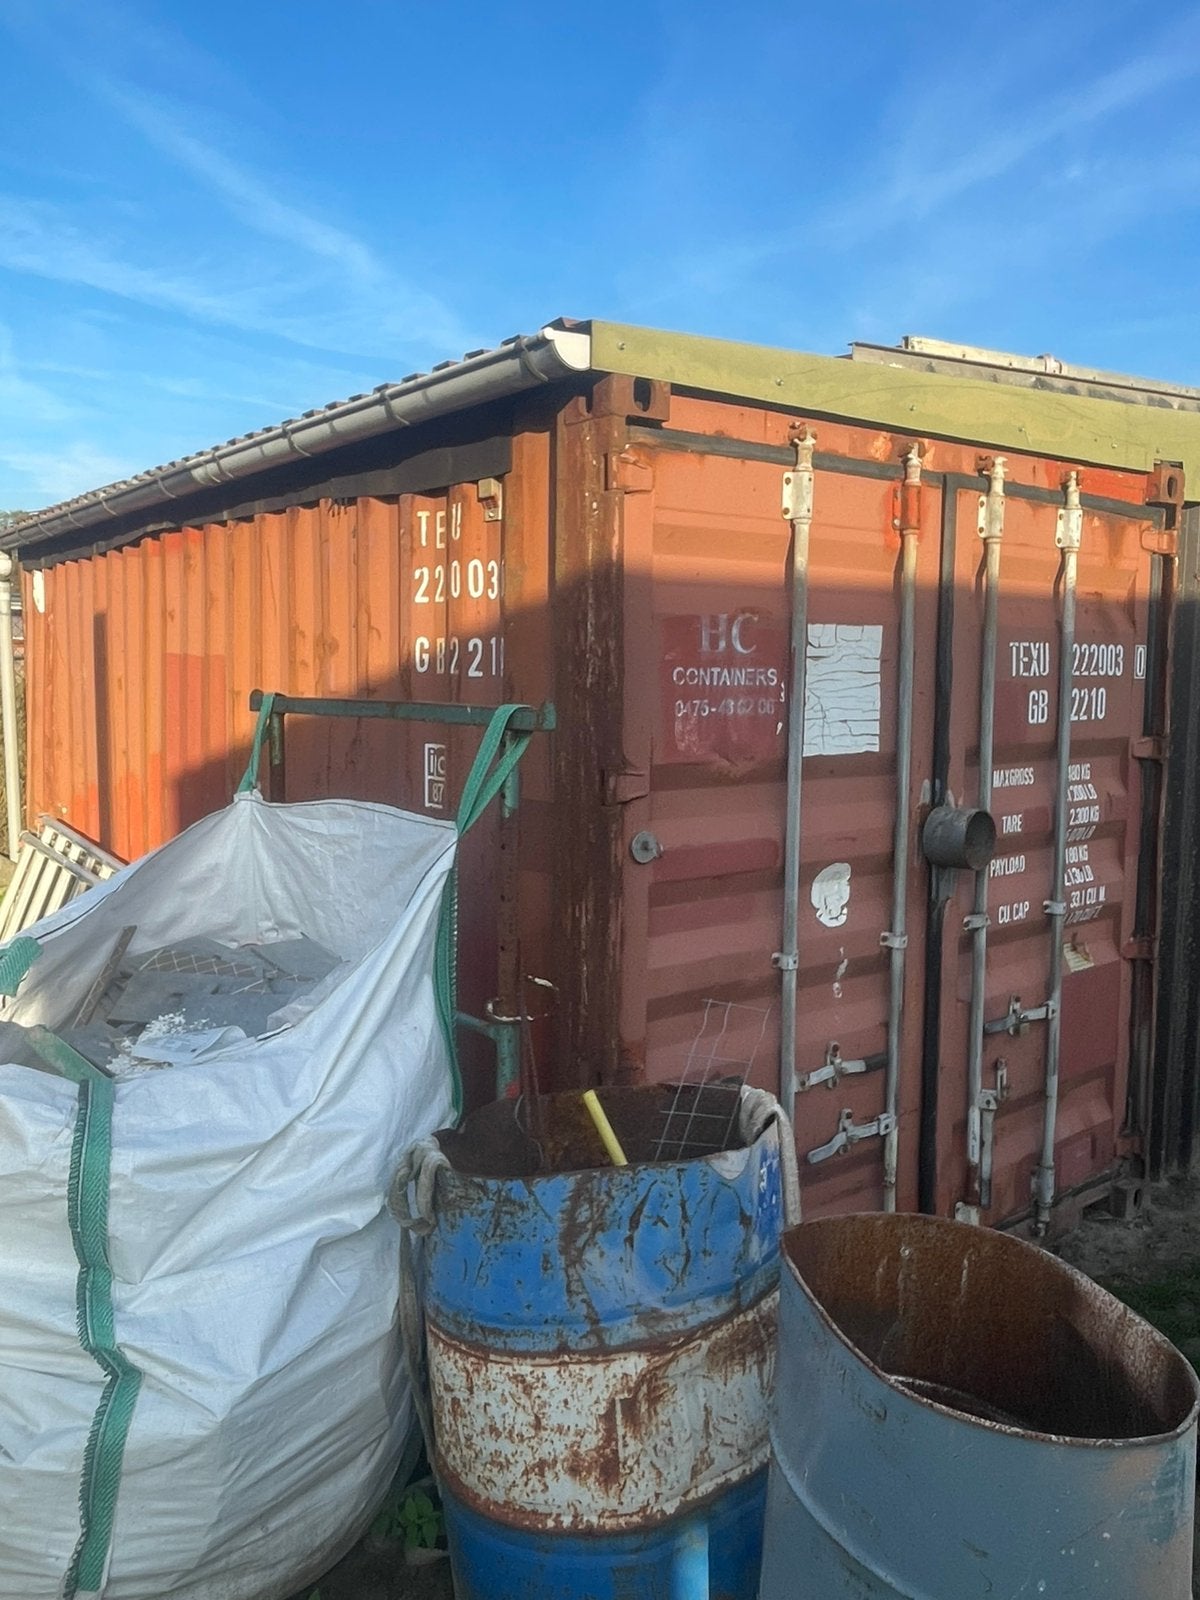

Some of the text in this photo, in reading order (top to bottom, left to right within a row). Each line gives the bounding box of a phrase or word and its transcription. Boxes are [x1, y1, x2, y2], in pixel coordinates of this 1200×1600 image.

[1009, 642, 1049, 677] TEXU
[1071, 643, 1124, 677] 222003
[673, 667, 778, 686] CONTAINERS
[1028, 687, 1107, 724] GB 2210
[1002, 814, 1023, 835] TARE
[990, 855, 1026, 878] PAYLOAD
[1013, 901, 1030, 921] CAP
